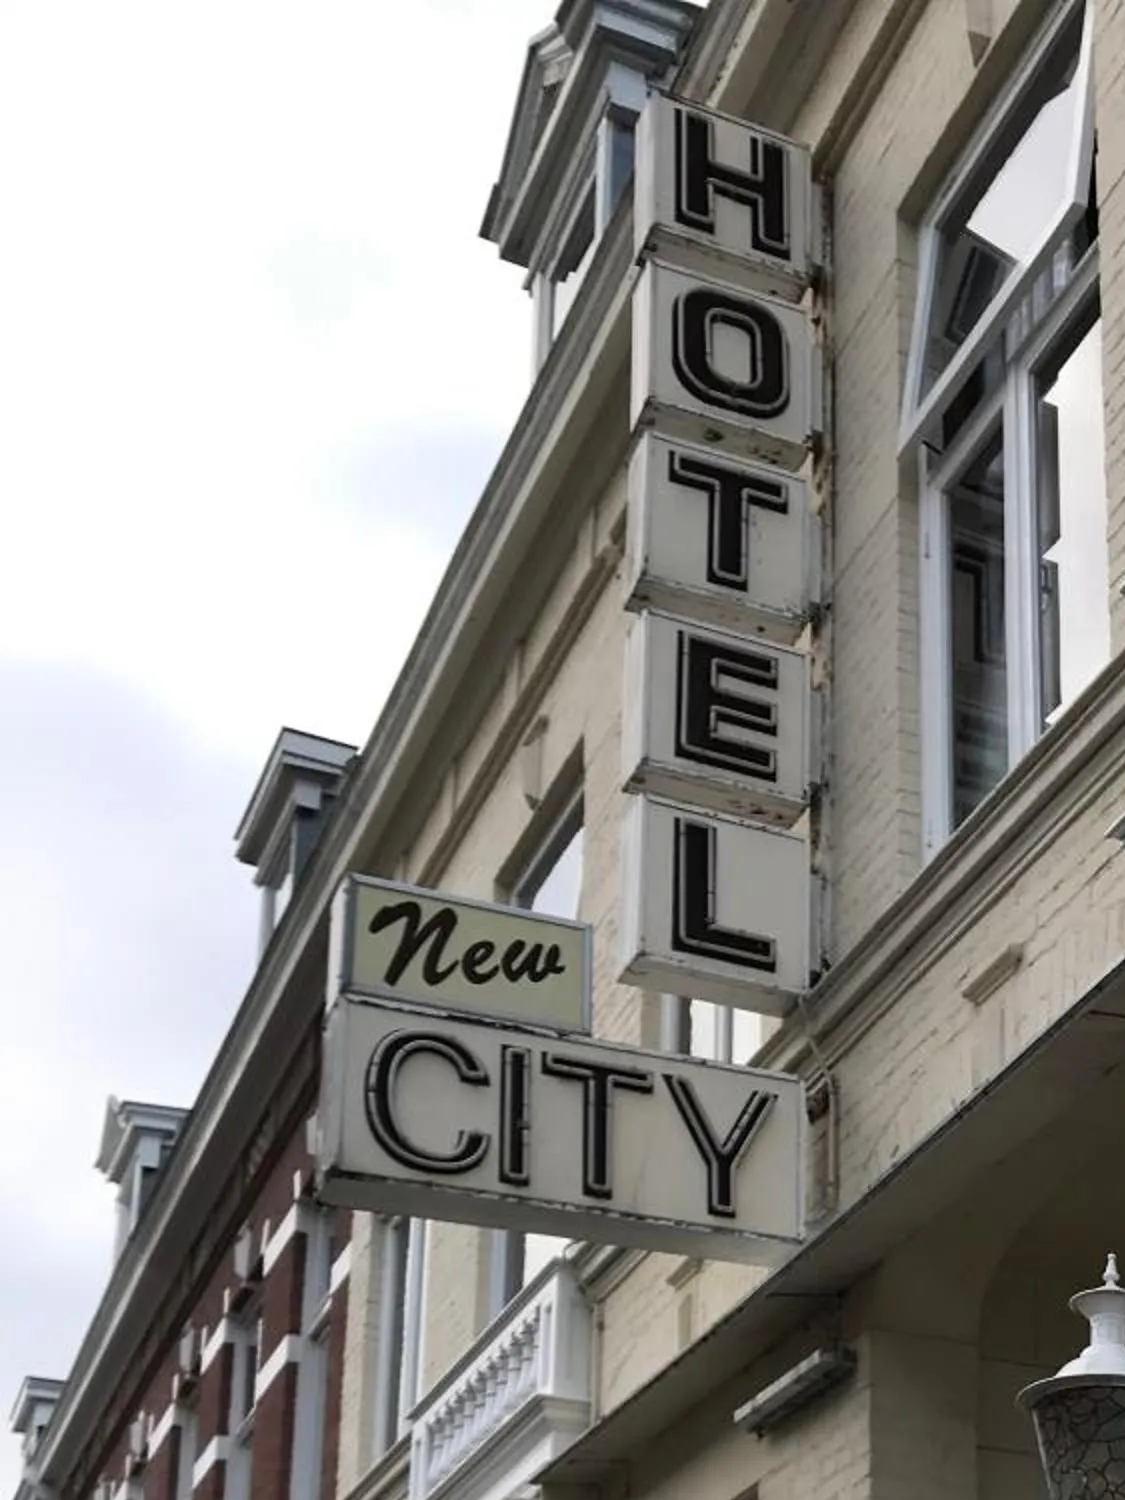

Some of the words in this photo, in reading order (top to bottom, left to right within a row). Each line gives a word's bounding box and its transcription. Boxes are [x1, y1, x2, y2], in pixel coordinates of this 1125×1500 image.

[668, 107, 791, 974] HOTEL
[368, 901, 566, 987] New
[364, 1028, 780, 1218] CITY
